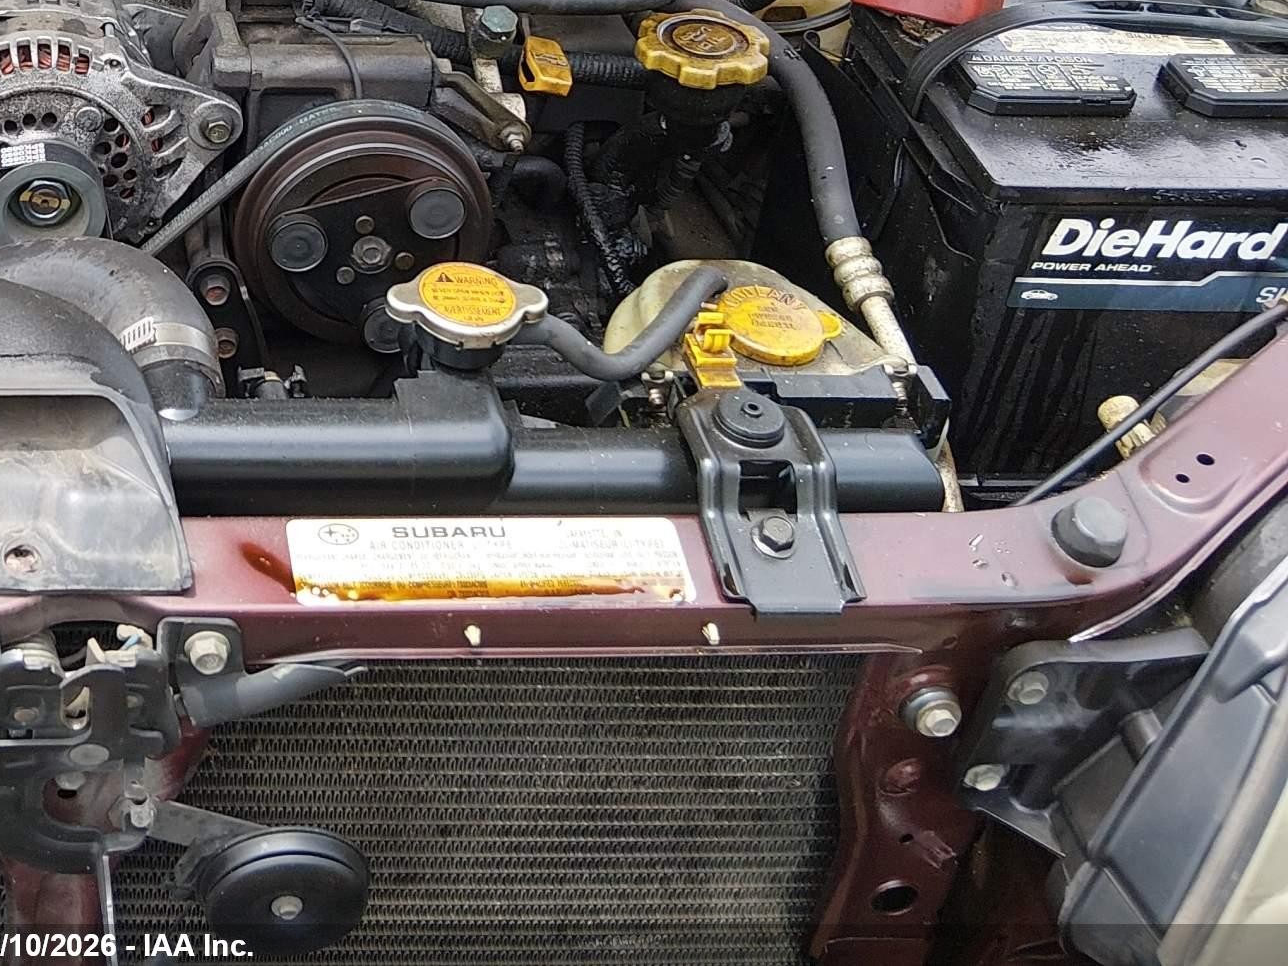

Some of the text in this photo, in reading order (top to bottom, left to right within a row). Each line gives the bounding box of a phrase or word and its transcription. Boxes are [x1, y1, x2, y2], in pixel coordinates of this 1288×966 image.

[982, 54, 1034, 63] DANGER
[1047, 55, 1094, 64] POISON
[1041, 218, 1288, 261] DieHard
[1031, 261, 1153, 273] POWER AHEAD
[391, 526, 506, 538] SUBARU
